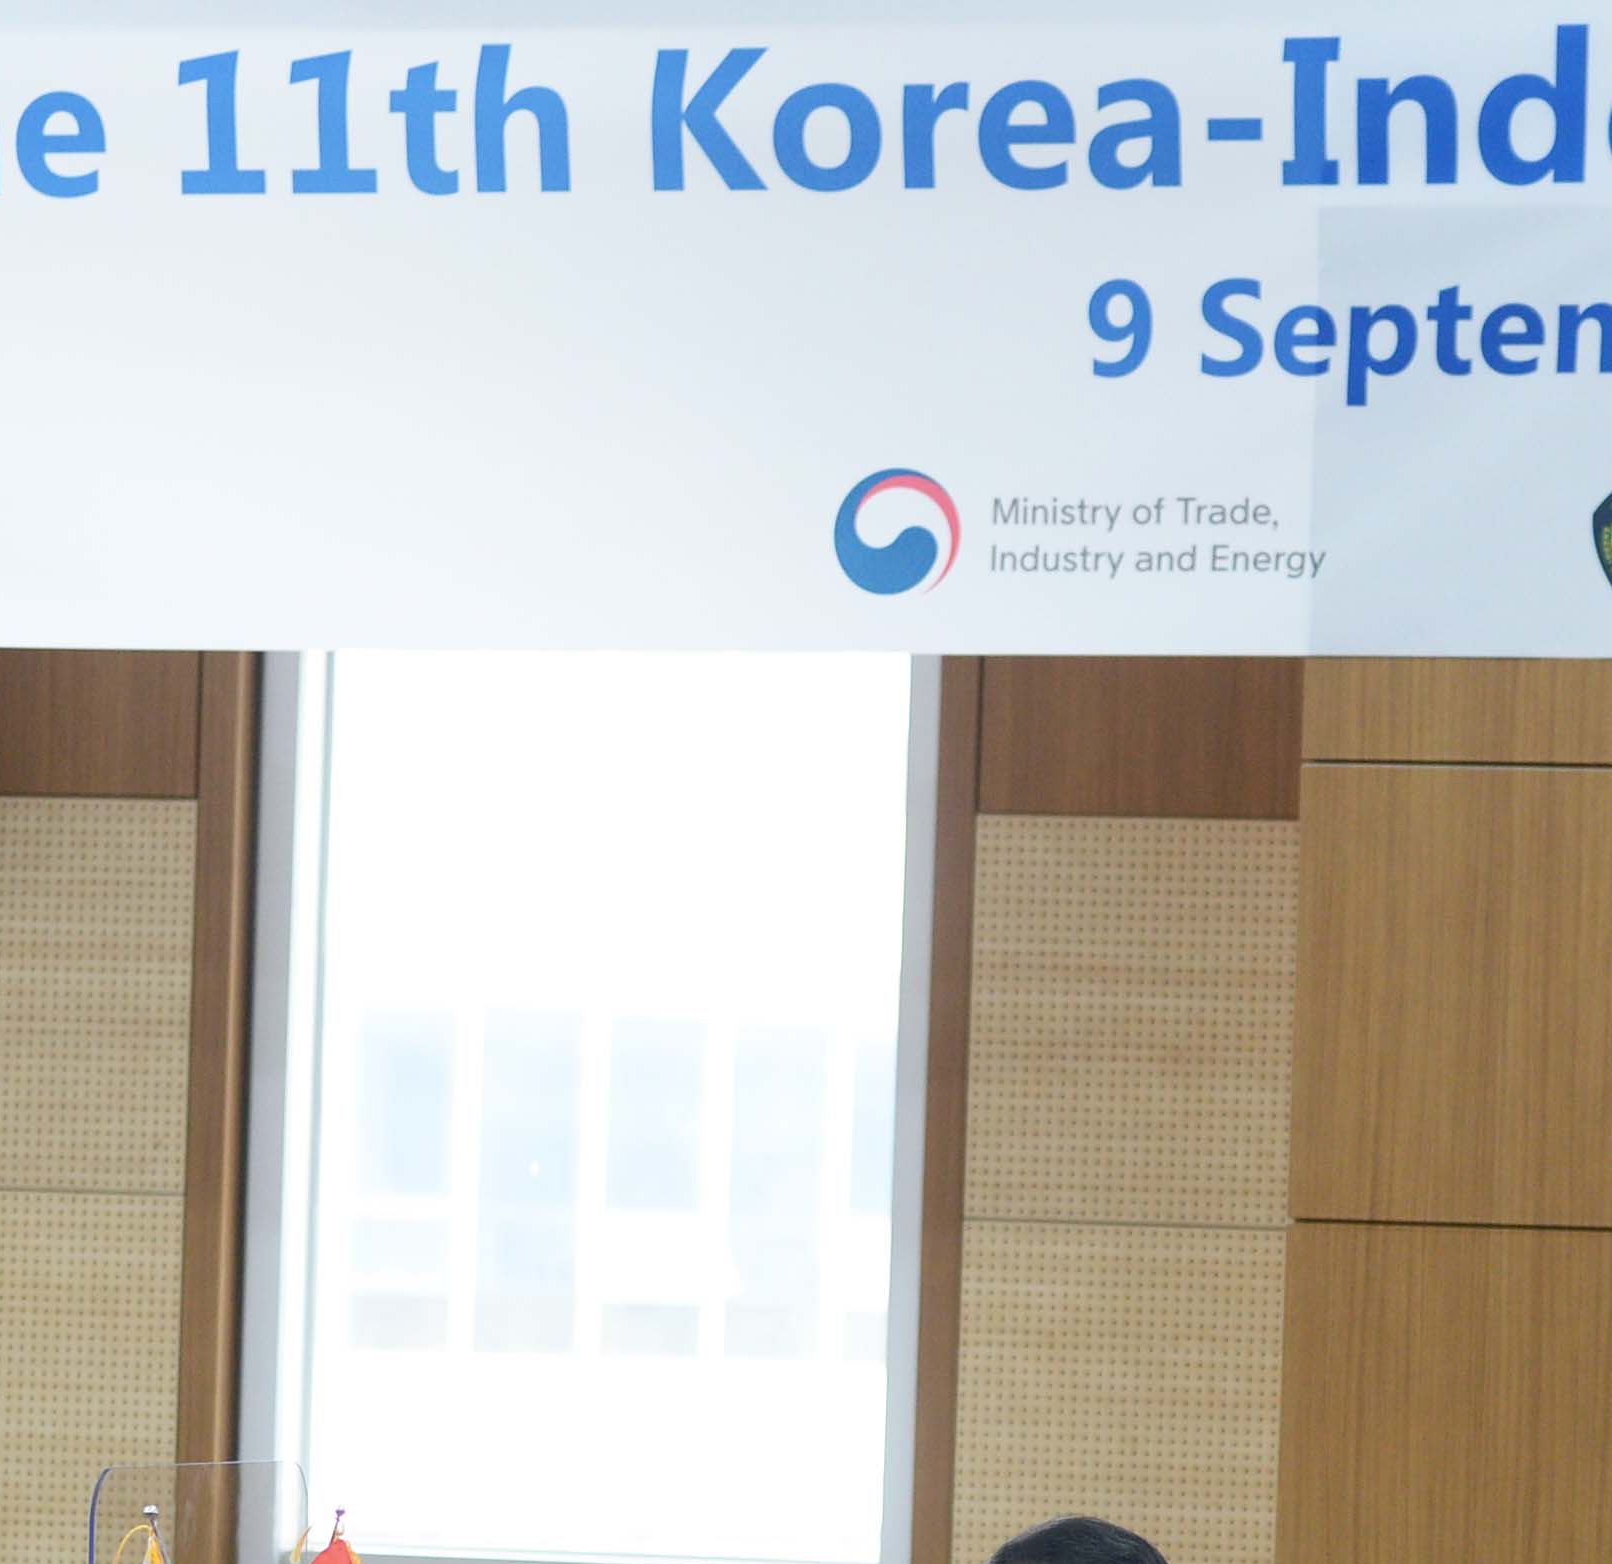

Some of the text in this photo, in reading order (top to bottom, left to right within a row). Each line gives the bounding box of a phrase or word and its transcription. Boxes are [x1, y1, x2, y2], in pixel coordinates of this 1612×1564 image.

[179, 44, 570, 195] 11th
[1088, 279, 1152, 378] 9
[991, 497, 1279, 532] Ministry of Trade,
[990, 544, 1327, 579] Industry and Energy
